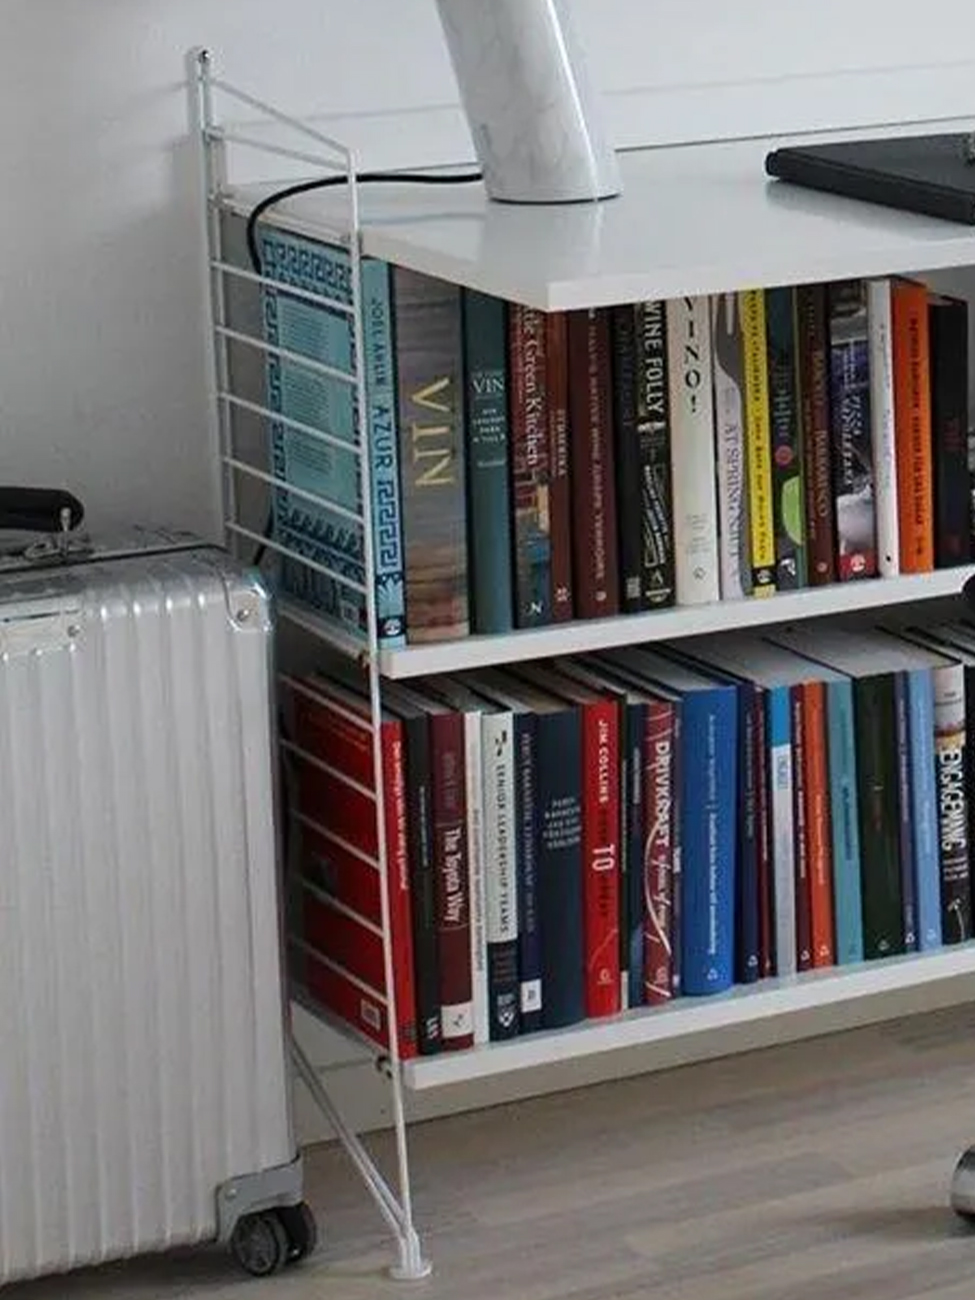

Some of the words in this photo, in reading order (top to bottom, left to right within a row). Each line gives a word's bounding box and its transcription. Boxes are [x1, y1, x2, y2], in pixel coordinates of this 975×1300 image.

[643, 300, 664, 352] WINE
[473, 379, 504, 393] VIN
[521, 338, 541, 392] Green
[645, 356, 666, 414] FOLLY
[373, 406, 394, 470] AZUR
[410, 376, 455, 487] VIN
[523, 397, 545, 465] Kitchen
[598, 719, 610, 744] JIM
[598, 747, 610, 803] COLLINS
[443, 828, 461, 851] The
[592, 843, 616, 872] TO
[441, 853, 462, 893] Toyota
[444, 893, 464, 923] Way
